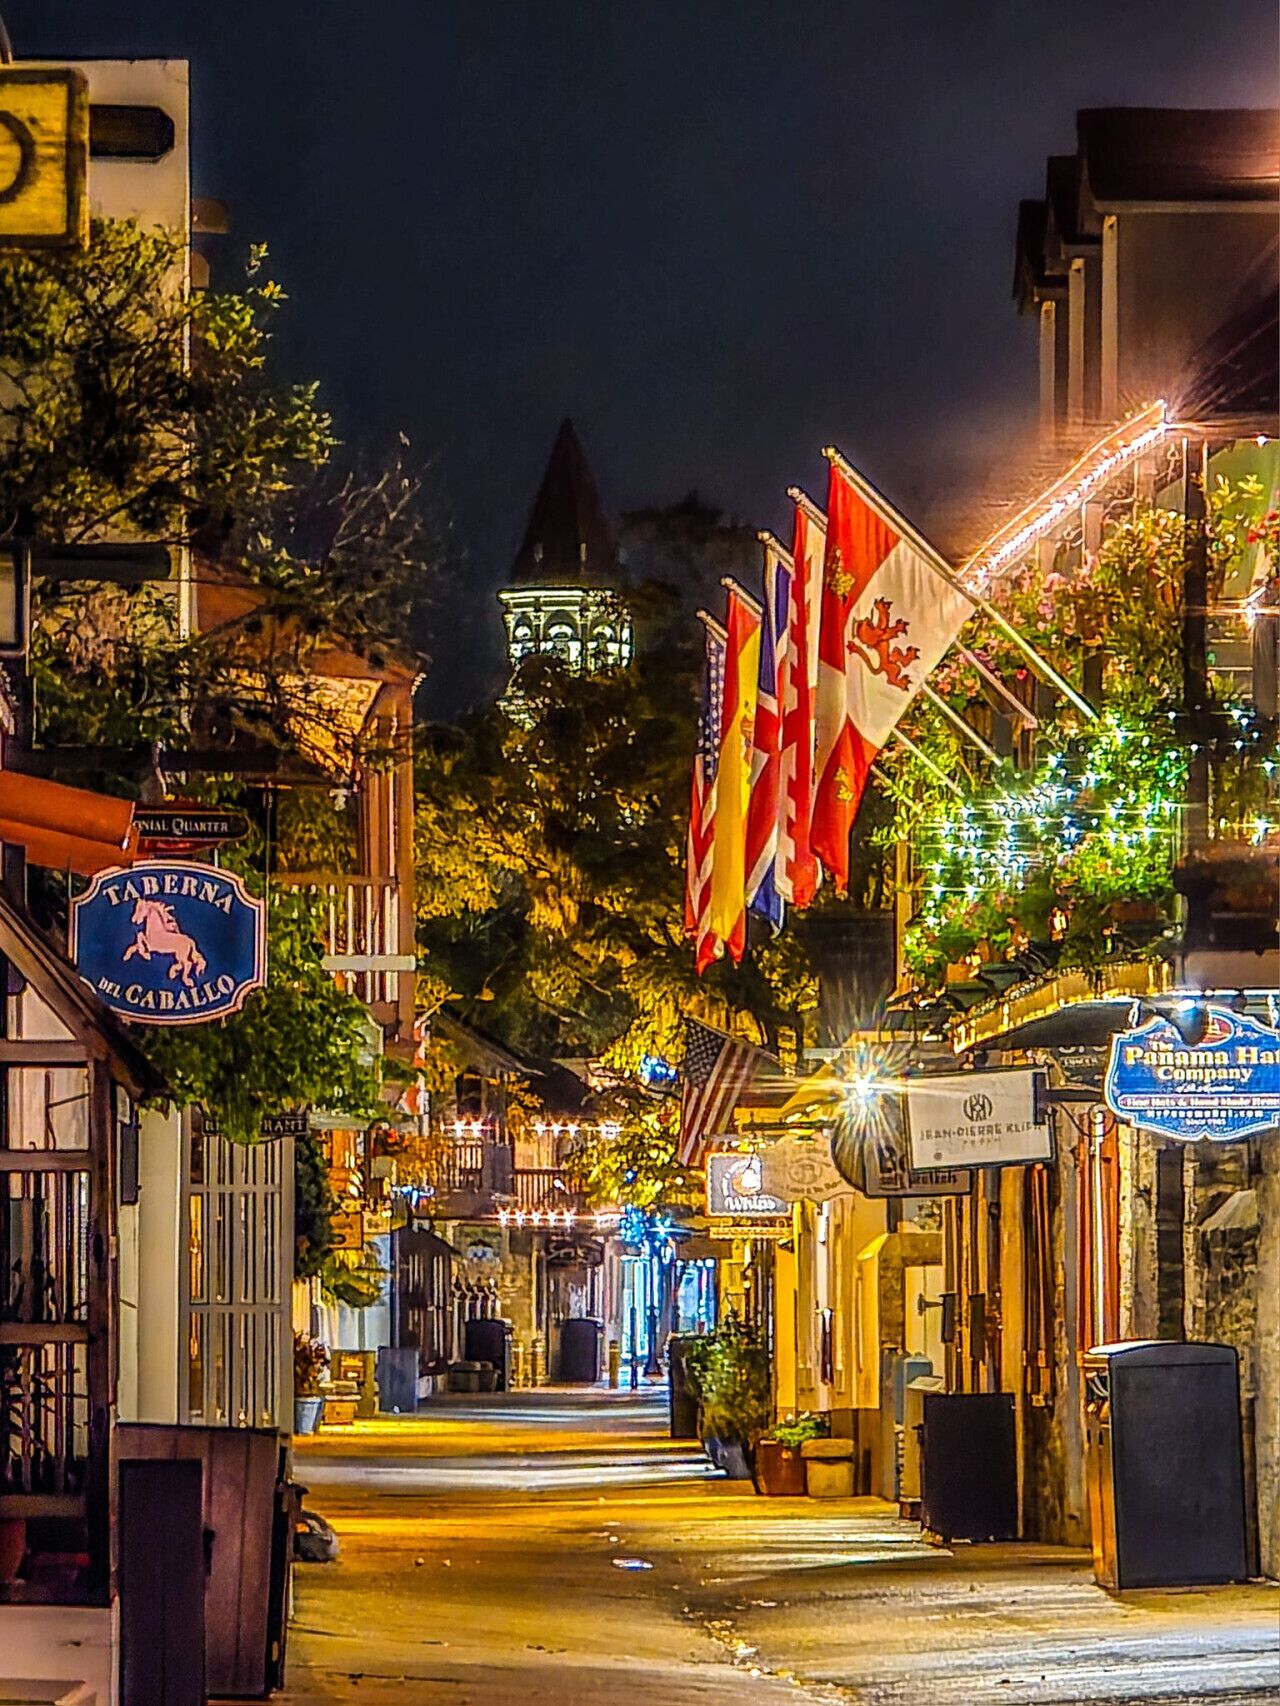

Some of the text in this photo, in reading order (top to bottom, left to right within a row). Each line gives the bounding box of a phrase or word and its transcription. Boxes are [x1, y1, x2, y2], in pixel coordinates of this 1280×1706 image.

[103, 874, 233, 914] TABERNA
[98, 975, 235, 1010] DEL CABALLO
[1149, 1039, 1174, 1051] The
[1124, 1046, 1230, 1065] Panama
[1156, 1066, 1252, 1083] Company
